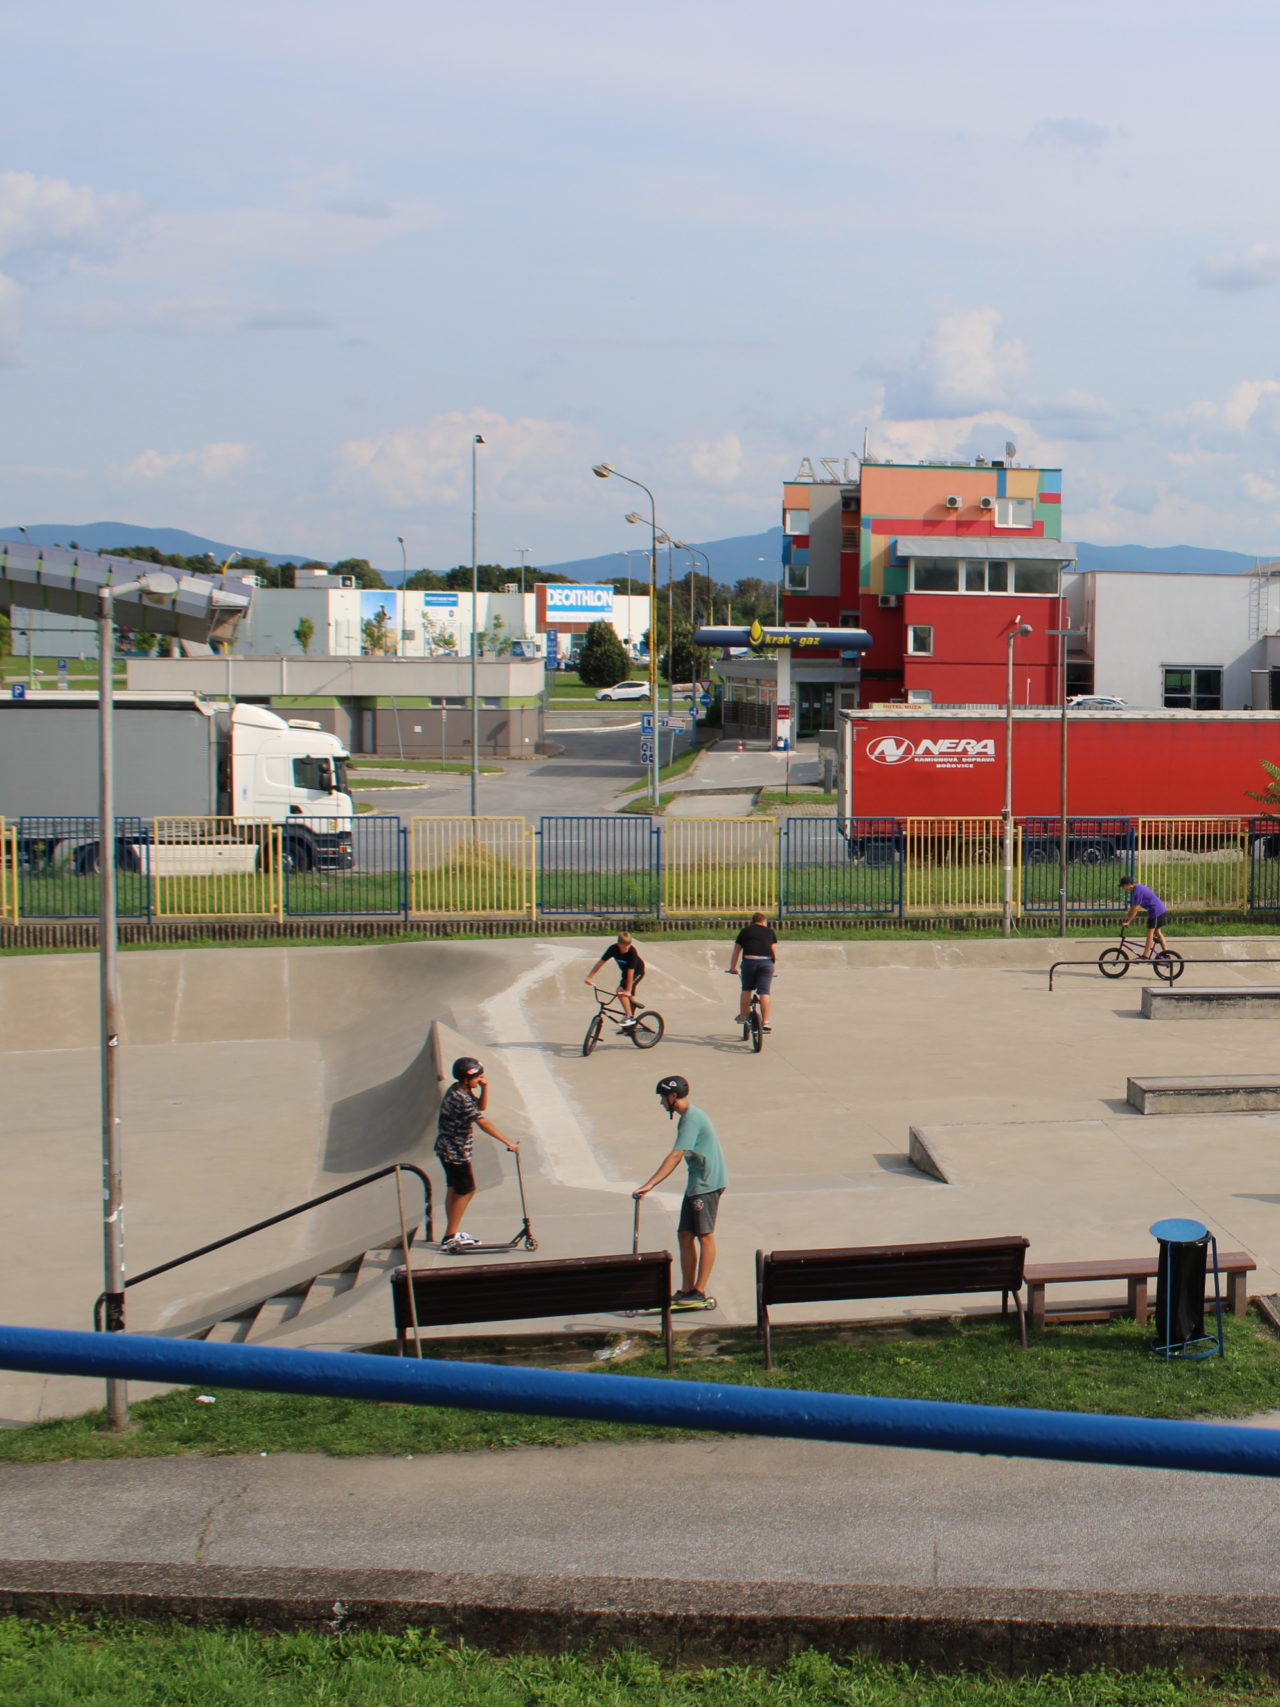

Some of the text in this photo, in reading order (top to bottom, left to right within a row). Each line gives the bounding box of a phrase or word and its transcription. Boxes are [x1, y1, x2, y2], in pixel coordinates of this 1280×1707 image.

[547, 589, 613, 606] DECATHLON
[766, 634, 791, 644] krak
[800, 636, 821, 647] gaz
[915, 738, 995, 755] NERA
